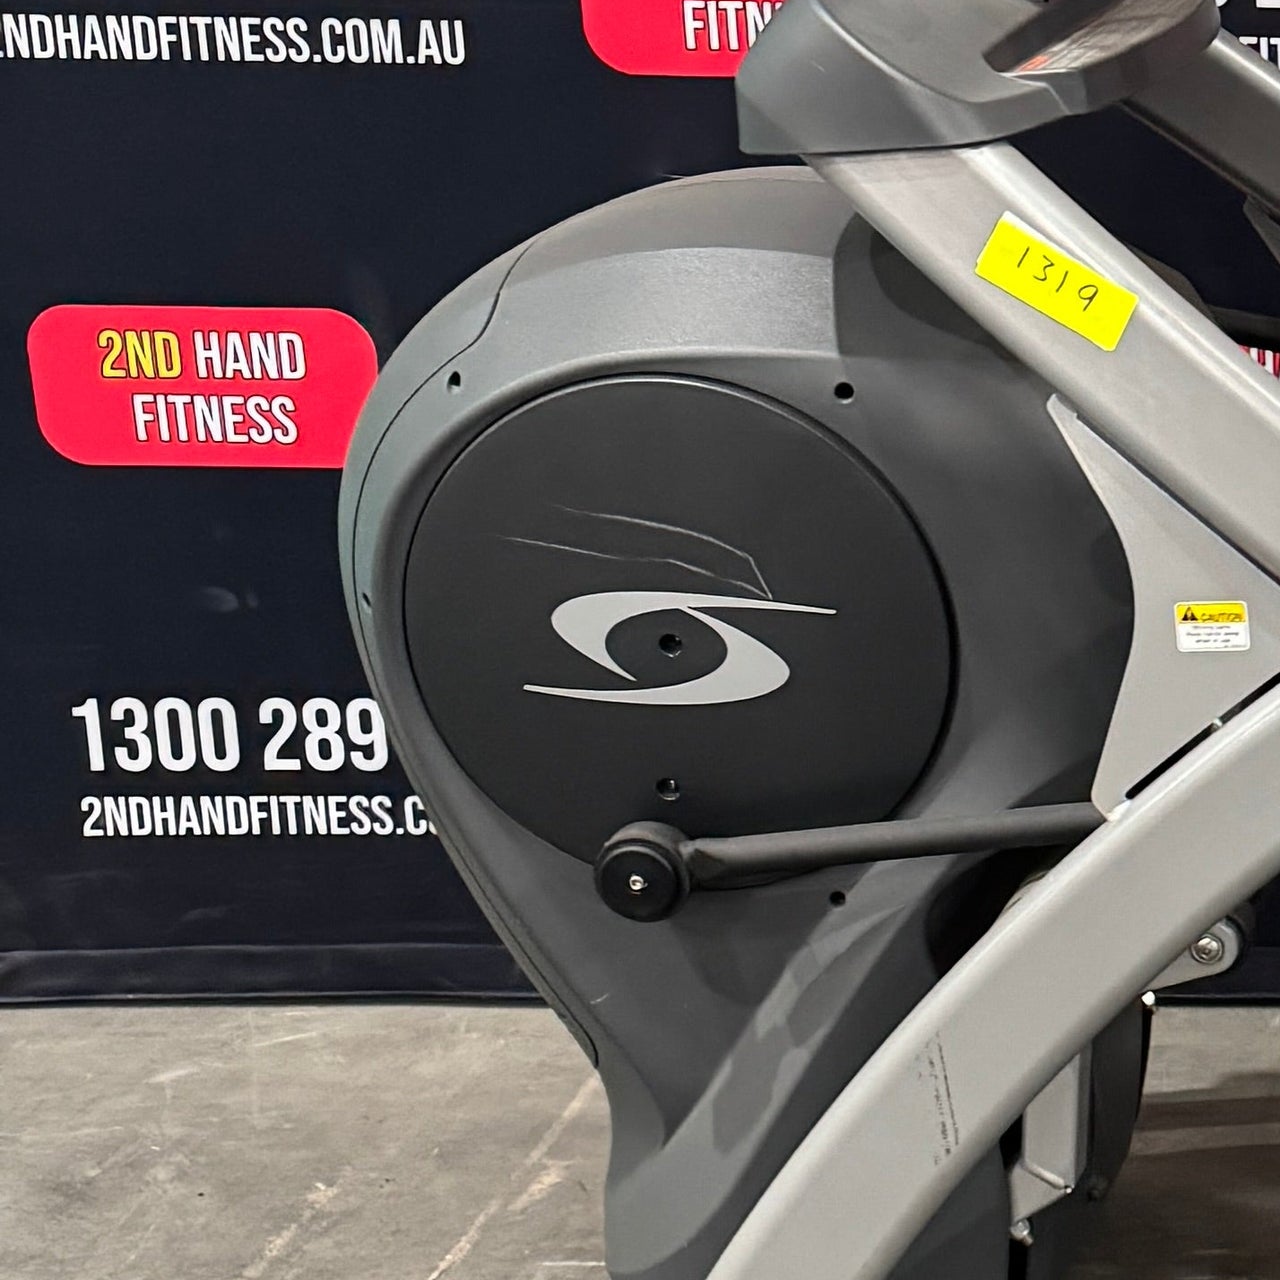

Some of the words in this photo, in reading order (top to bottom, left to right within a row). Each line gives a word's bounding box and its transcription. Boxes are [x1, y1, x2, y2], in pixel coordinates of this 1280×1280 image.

[0, 13, 466, 65] NDHANDFITNESS.COM.AU
[682, 0, 783, 51] FITN
[1016, 246, 1099, 312] 1319
[98, 329, 182, 378] 2ND
[193, 331, 306, 380] HAND
[133, 394, 298, 444] FITNESS
[71, 696, 241, 772] 1300
[258, 697, 389, 772] 289
[80, 795, 438, 839] 2NDHANDFITNESS.C
